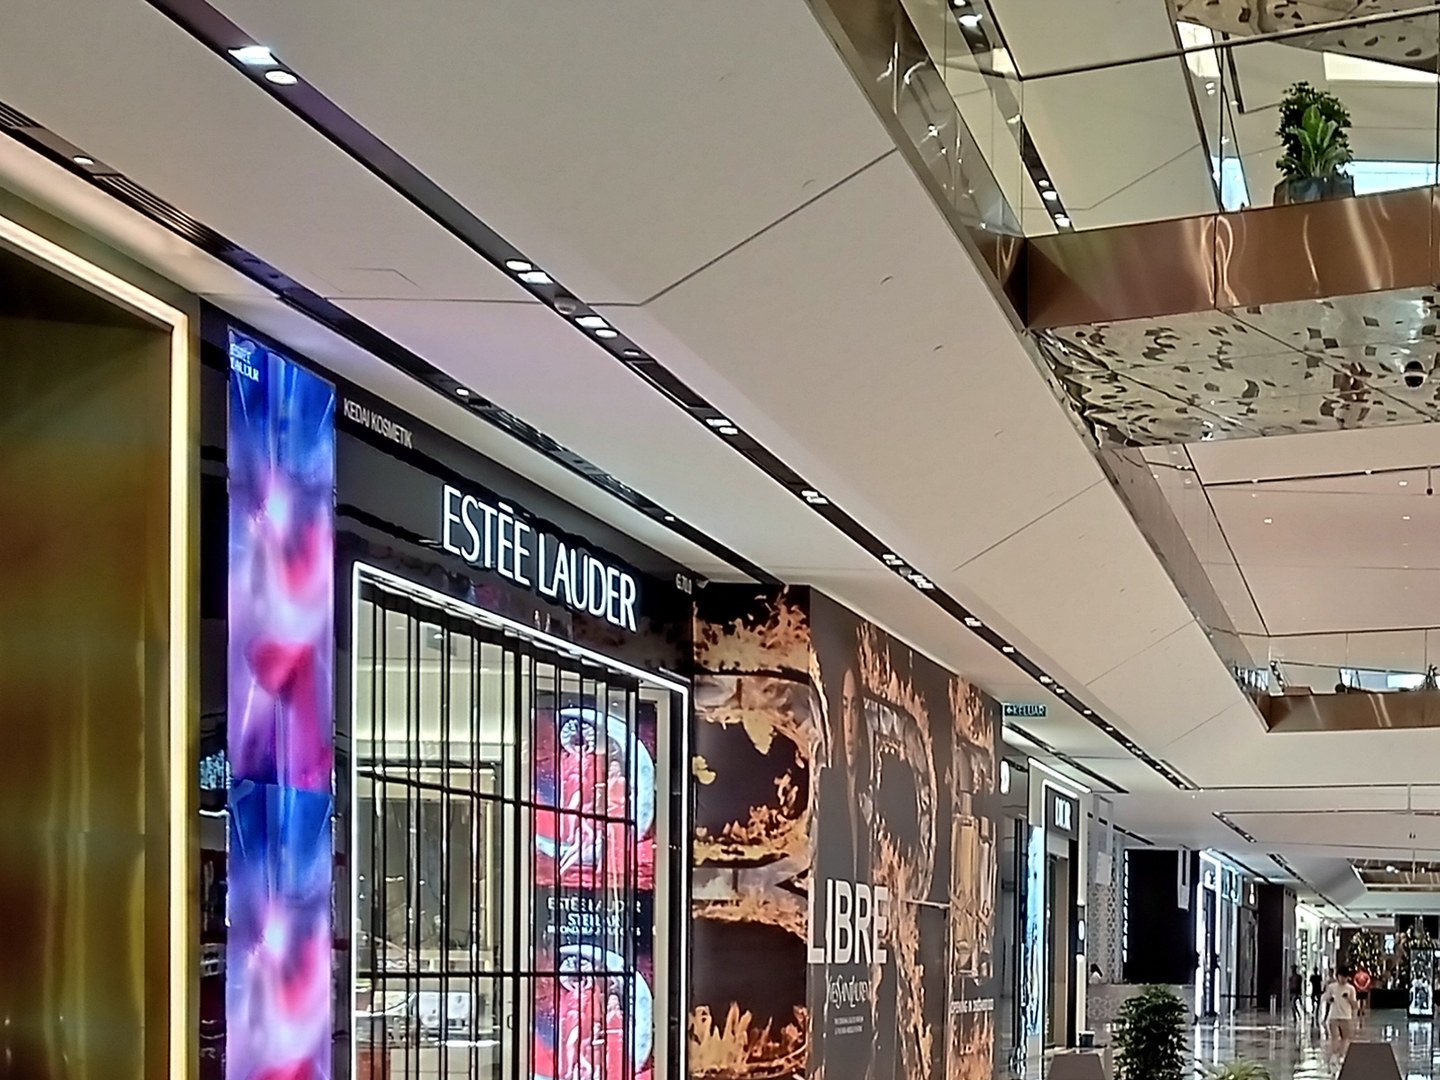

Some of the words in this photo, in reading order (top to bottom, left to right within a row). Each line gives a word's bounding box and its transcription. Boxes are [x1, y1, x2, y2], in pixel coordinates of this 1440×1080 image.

[343, 398, 370, 428] KEDAI
[371, 411, 413, 449] KOSMETIK
[538, 532, 637, 632] LAUDER
[1013, 705, 1046, 717] KELUAR
[807, 878, 889, 964] LIBRE
